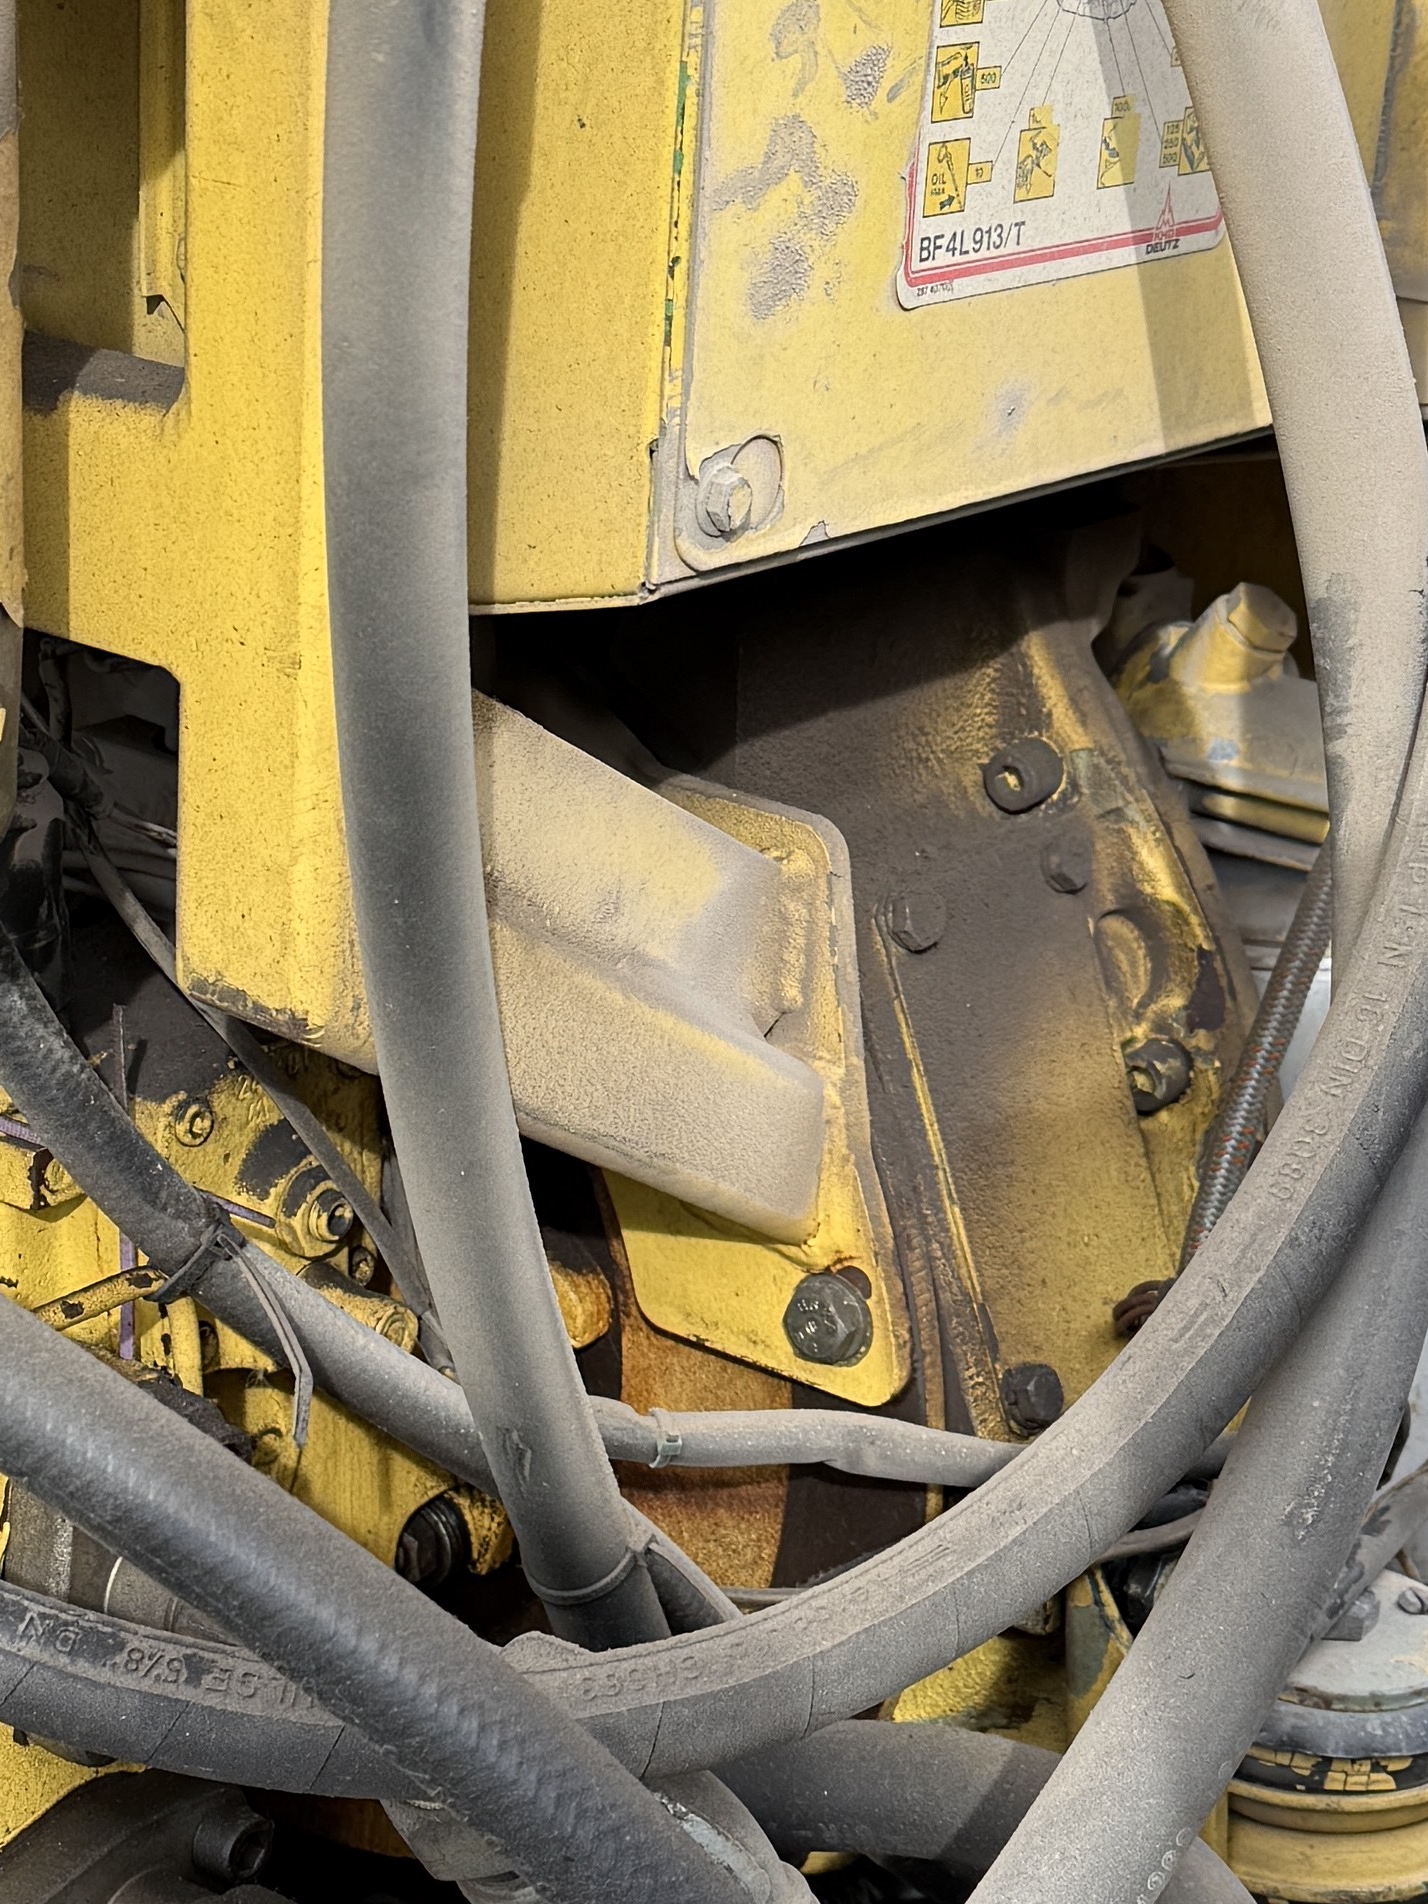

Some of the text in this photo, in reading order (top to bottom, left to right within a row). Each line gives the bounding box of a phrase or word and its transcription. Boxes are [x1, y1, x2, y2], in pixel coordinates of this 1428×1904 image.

[931, 172, 947, 185] OIL
[918, 220, 1026, 264] BF4L913/T
[1145, 238, 1180, 255] DEUTZ
